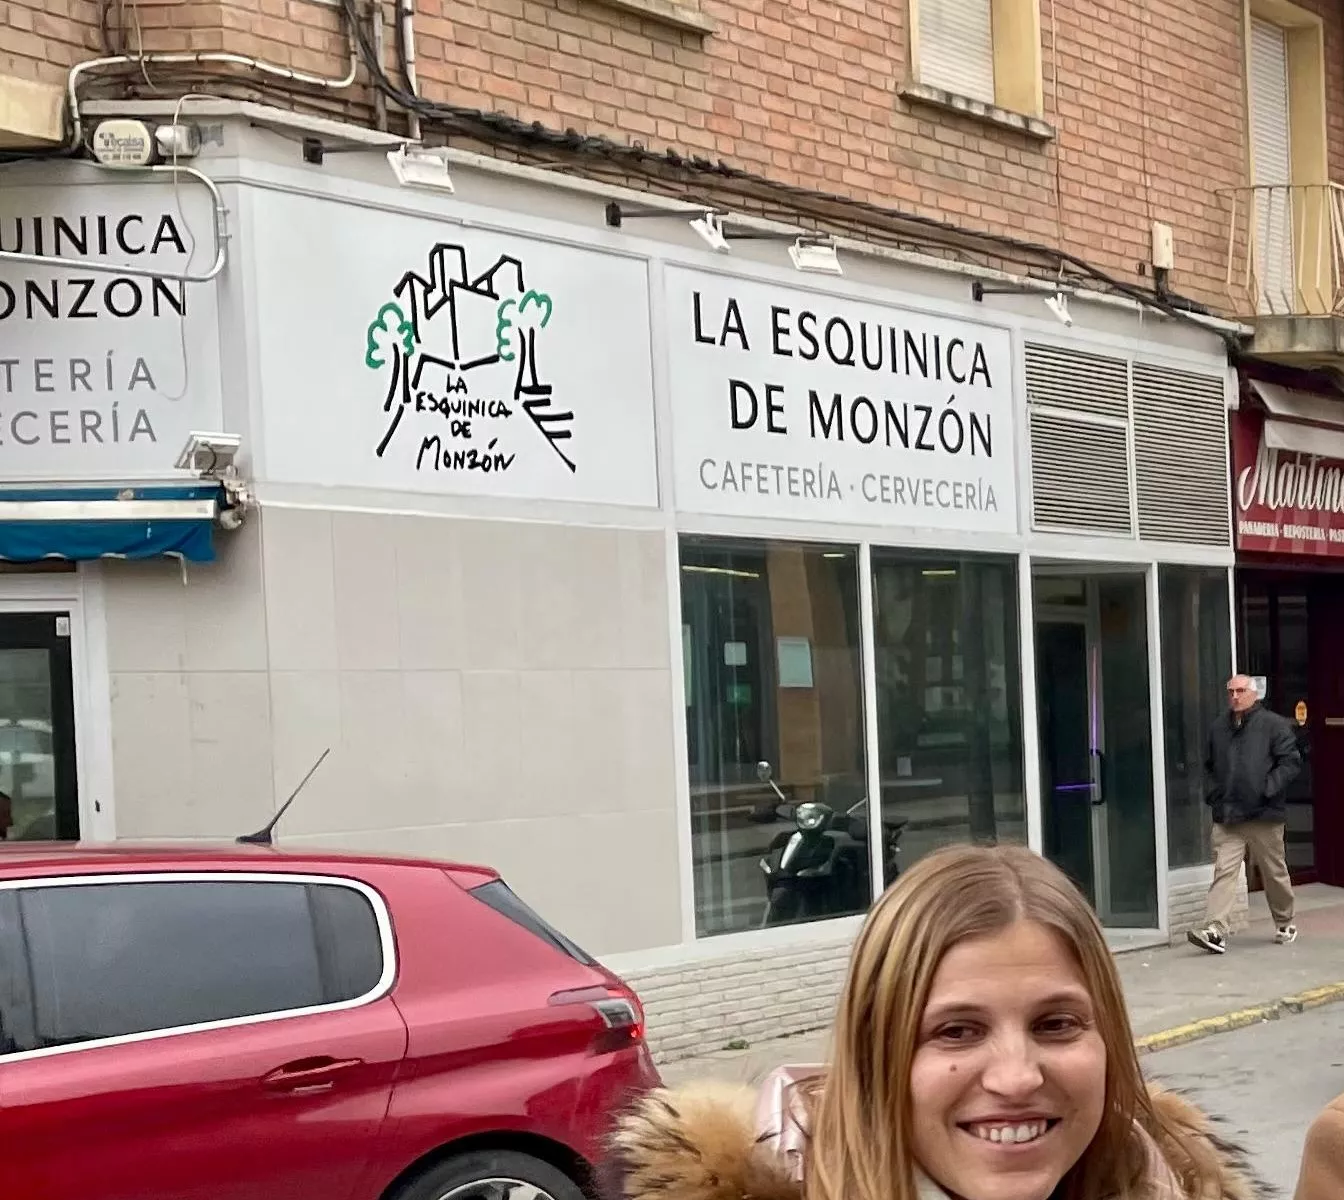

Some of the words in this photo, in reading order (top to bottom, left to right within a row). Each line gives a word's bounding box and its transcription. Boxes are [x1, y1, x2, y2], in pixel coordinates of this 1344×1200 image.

[692, 290, 750, 351] LA
[771, 304, 993, 389] ESQUINICA
[416, 391, 512, 419] ESQUINICA
[446, 373, 468, 394] LA
[0, 401, 158, 445] CERÍA
[450, 419, 472, 439] DE
[728, 378, 788, 435] DE
[808, 394, 993, 458] MONZÓN
[699, 457, 842, 500] CAFETERÍA
[861, 473, 999, 513] CERVECERÍA
